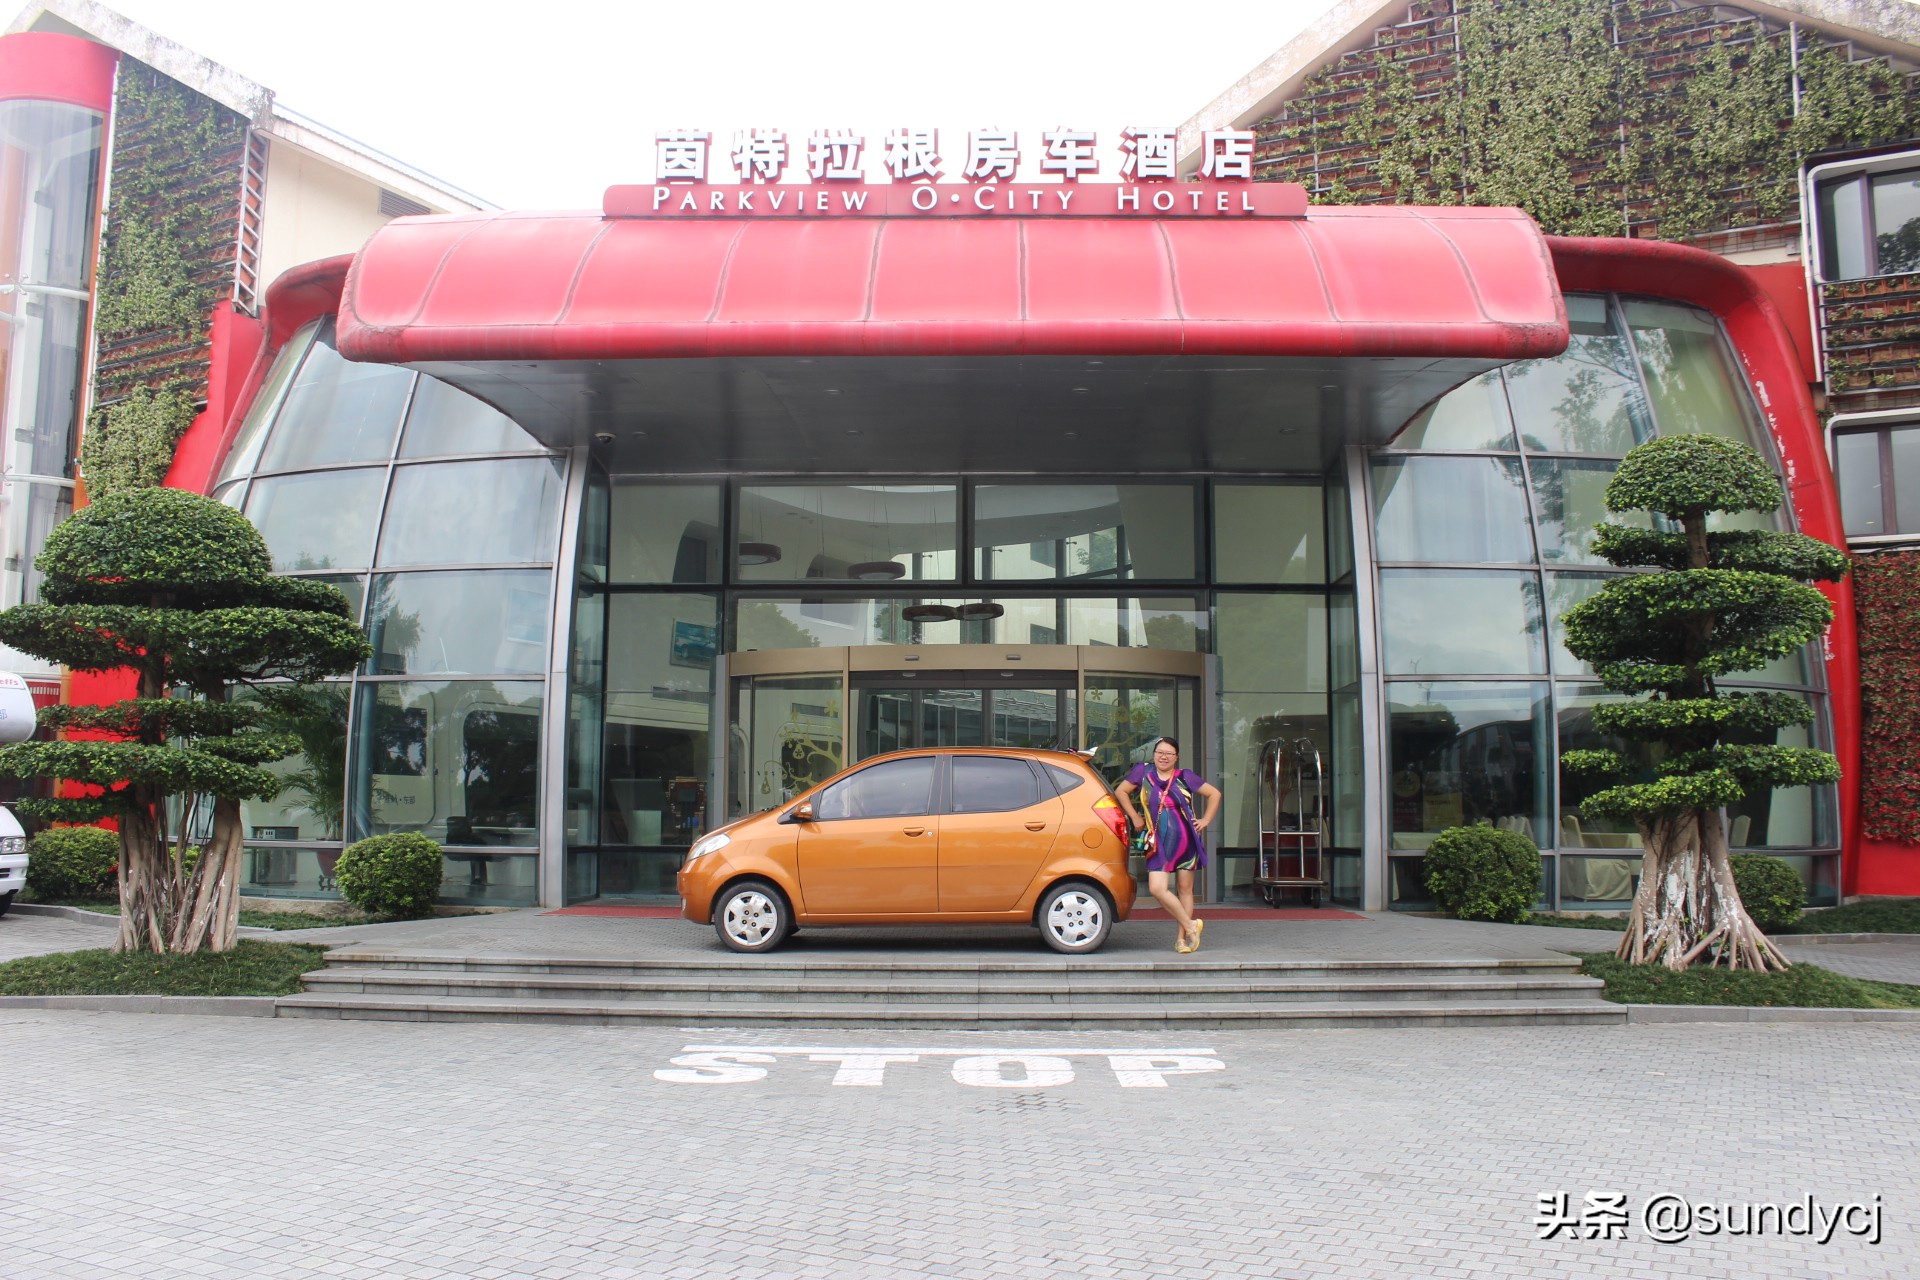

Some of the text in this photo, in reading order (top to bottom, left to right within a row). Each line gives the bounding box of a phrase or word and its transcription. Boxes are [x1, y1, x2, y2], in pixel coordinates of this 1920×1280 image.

[655, 128, 1254, 180] 茵特拉根房车酒店
[652, 186, 868, 210] PARKVIEW
[1117, 186, 1255, 211] HOTEL
[653, 1051, 1226, 1087] STOP
